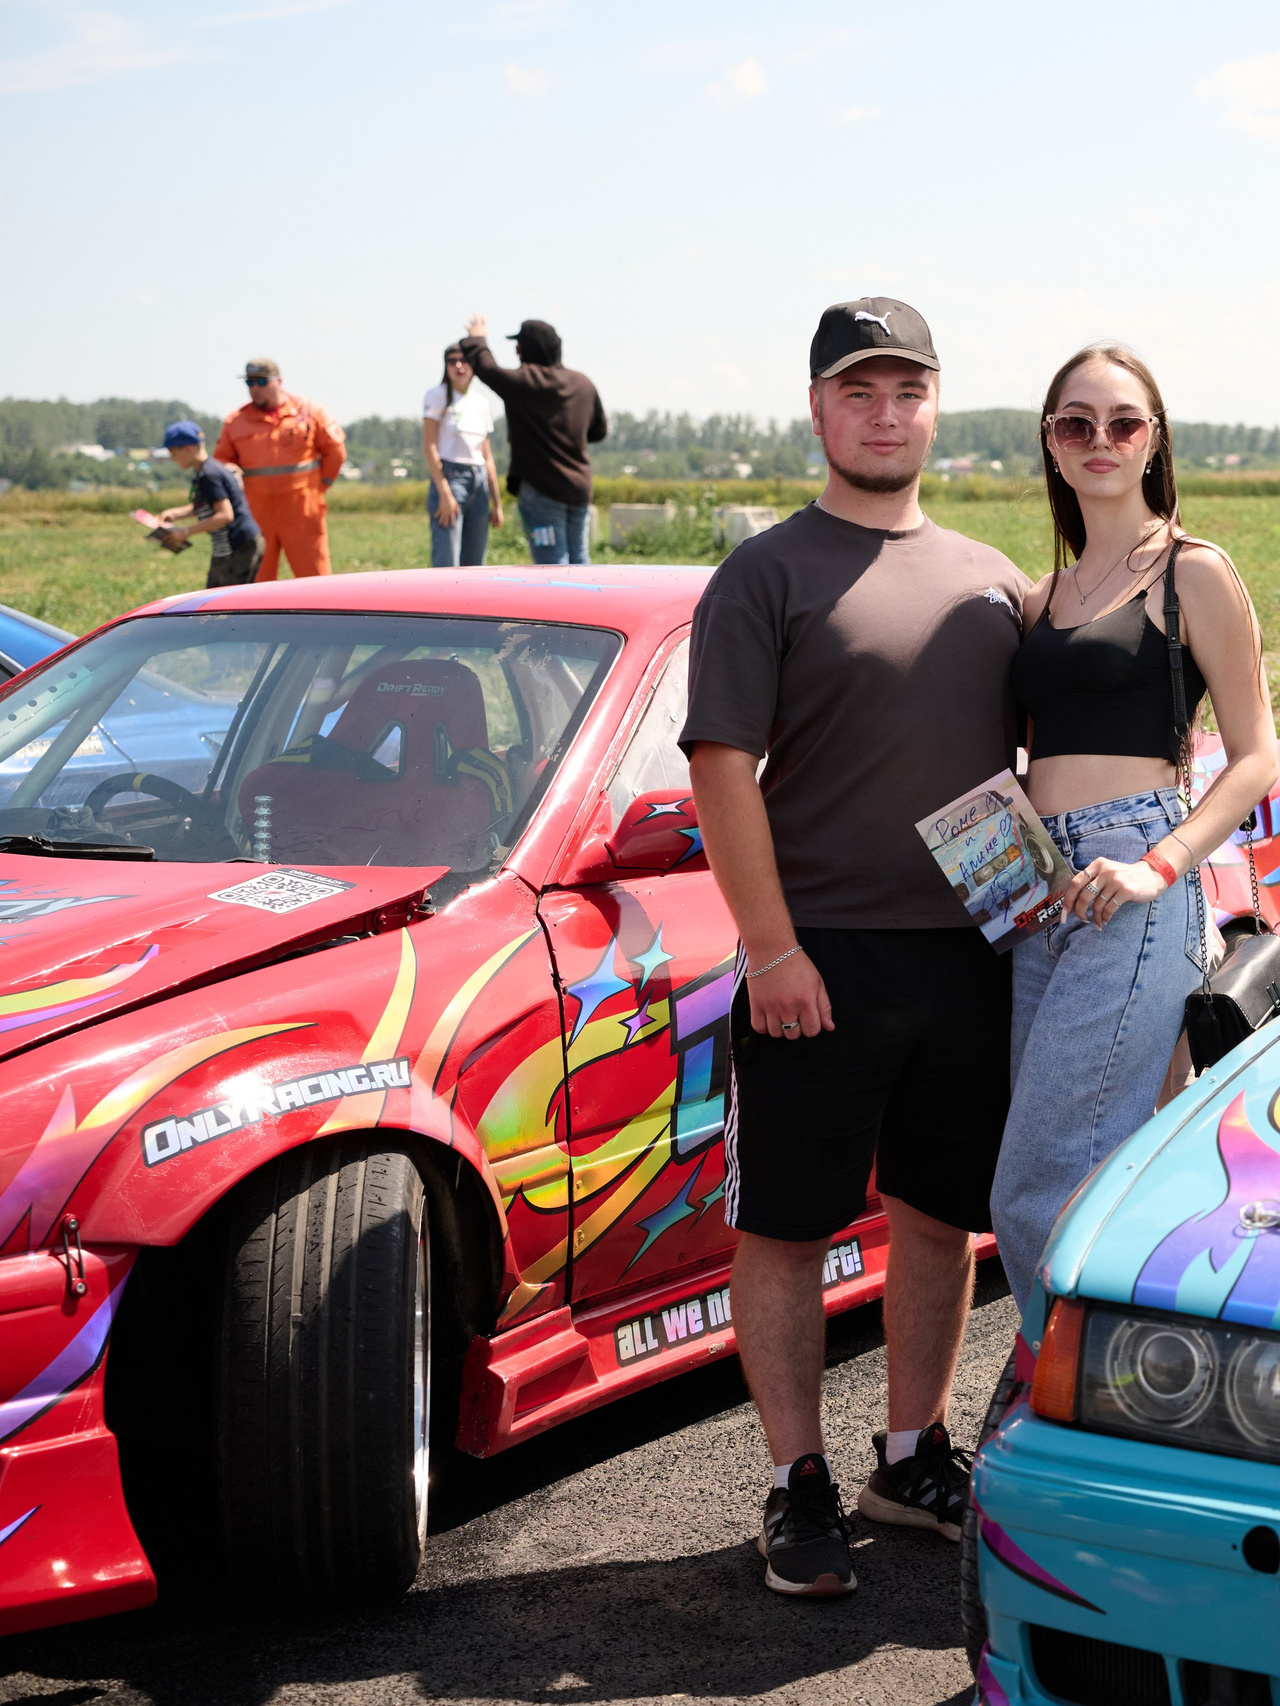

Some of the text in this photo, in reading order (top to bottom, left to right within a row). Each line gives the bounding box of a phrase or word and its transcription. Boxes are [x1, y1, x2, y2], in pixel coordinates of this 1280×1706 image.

[376, 682, 447, 695] DRIFT READY
[1036, 896, 1065, 923] REA
